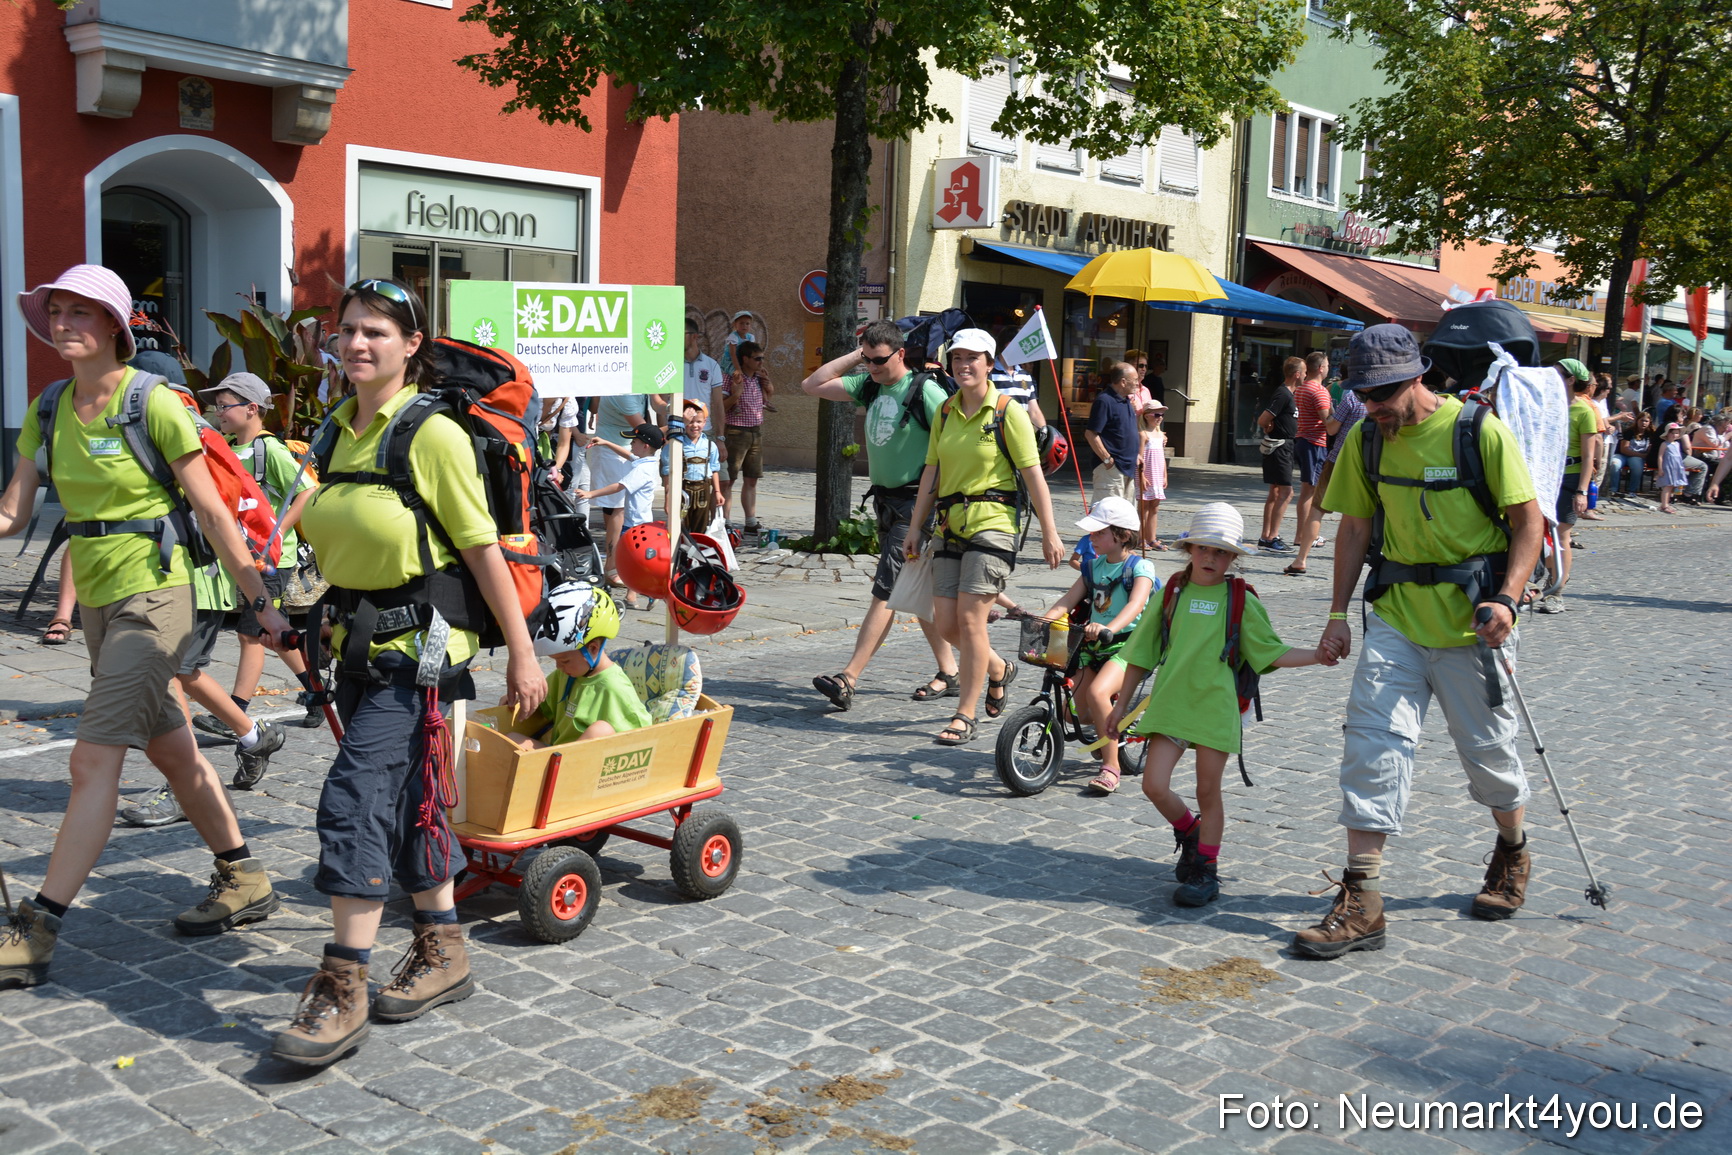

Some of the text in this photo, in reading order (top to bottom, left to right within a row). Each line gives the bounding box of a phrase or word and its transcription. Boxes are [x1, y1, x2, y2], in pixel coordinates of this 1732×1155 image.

[1005, 200, 1175, 252] STADT APOTHEKE
[1502, 276, 1537, 304] LEDER
[552, 295, 625, 333] DAV
[1029, 330, 1045, 348] DA
[516, 342, 629, 358] Deutscher Alpenverein
[553, 362, 596, 374] Neumarkt
[99, 440, 120, 449] DAV
[1434, 469, 1454, 477] DAV
[1199, 602, 1217, 611] DAV
[616, 749, 652, 772] DAV
